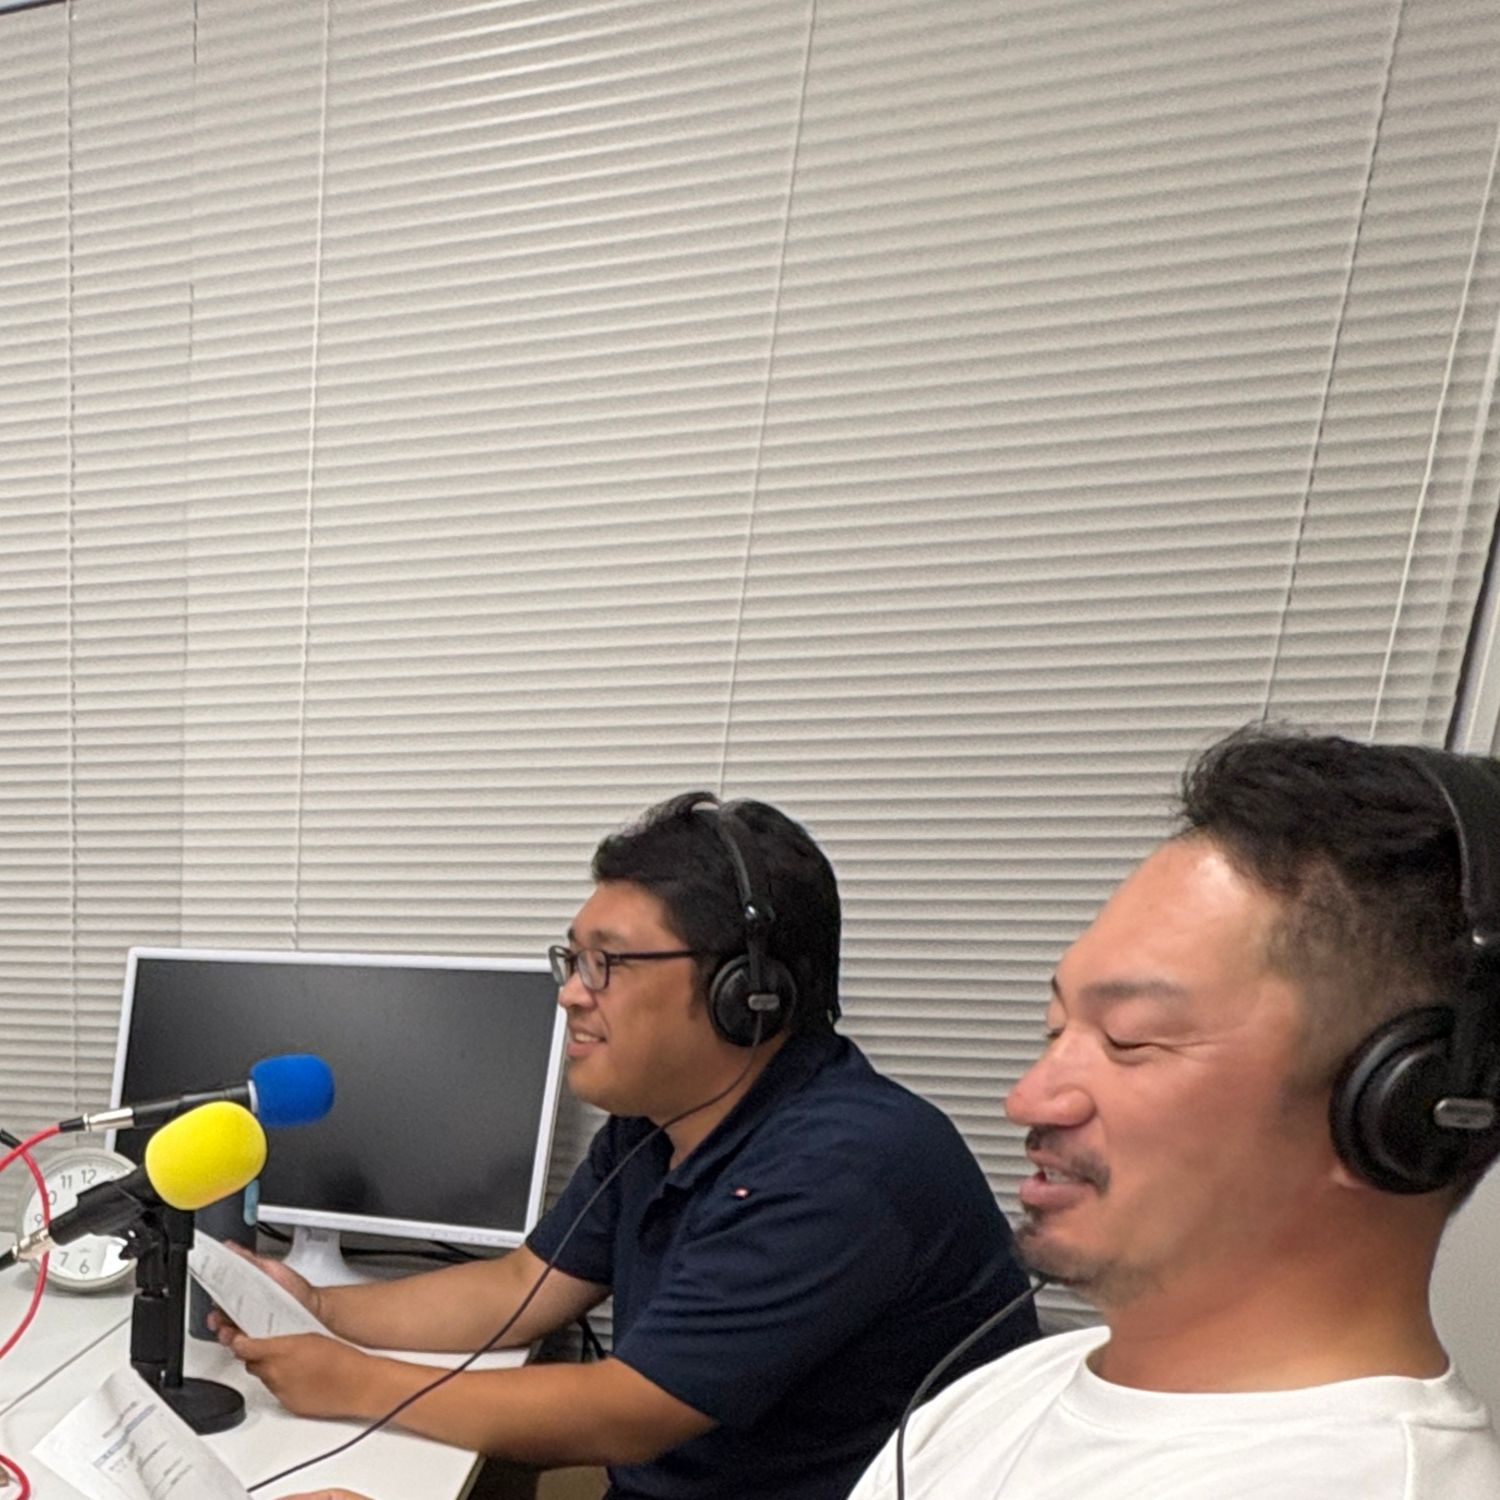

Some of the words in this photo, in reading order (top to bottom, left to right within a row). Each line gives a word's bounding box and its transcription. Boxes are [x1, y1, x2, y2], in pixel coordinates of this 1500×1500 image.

[61, 1175, 72, 1189] 11
[81, 1169, 97, 1184] 12
[34, 1213, 44, 1227] 9
[60, 1252, 69, 1267] 7
[79, 1260, 90, 1275] 6
